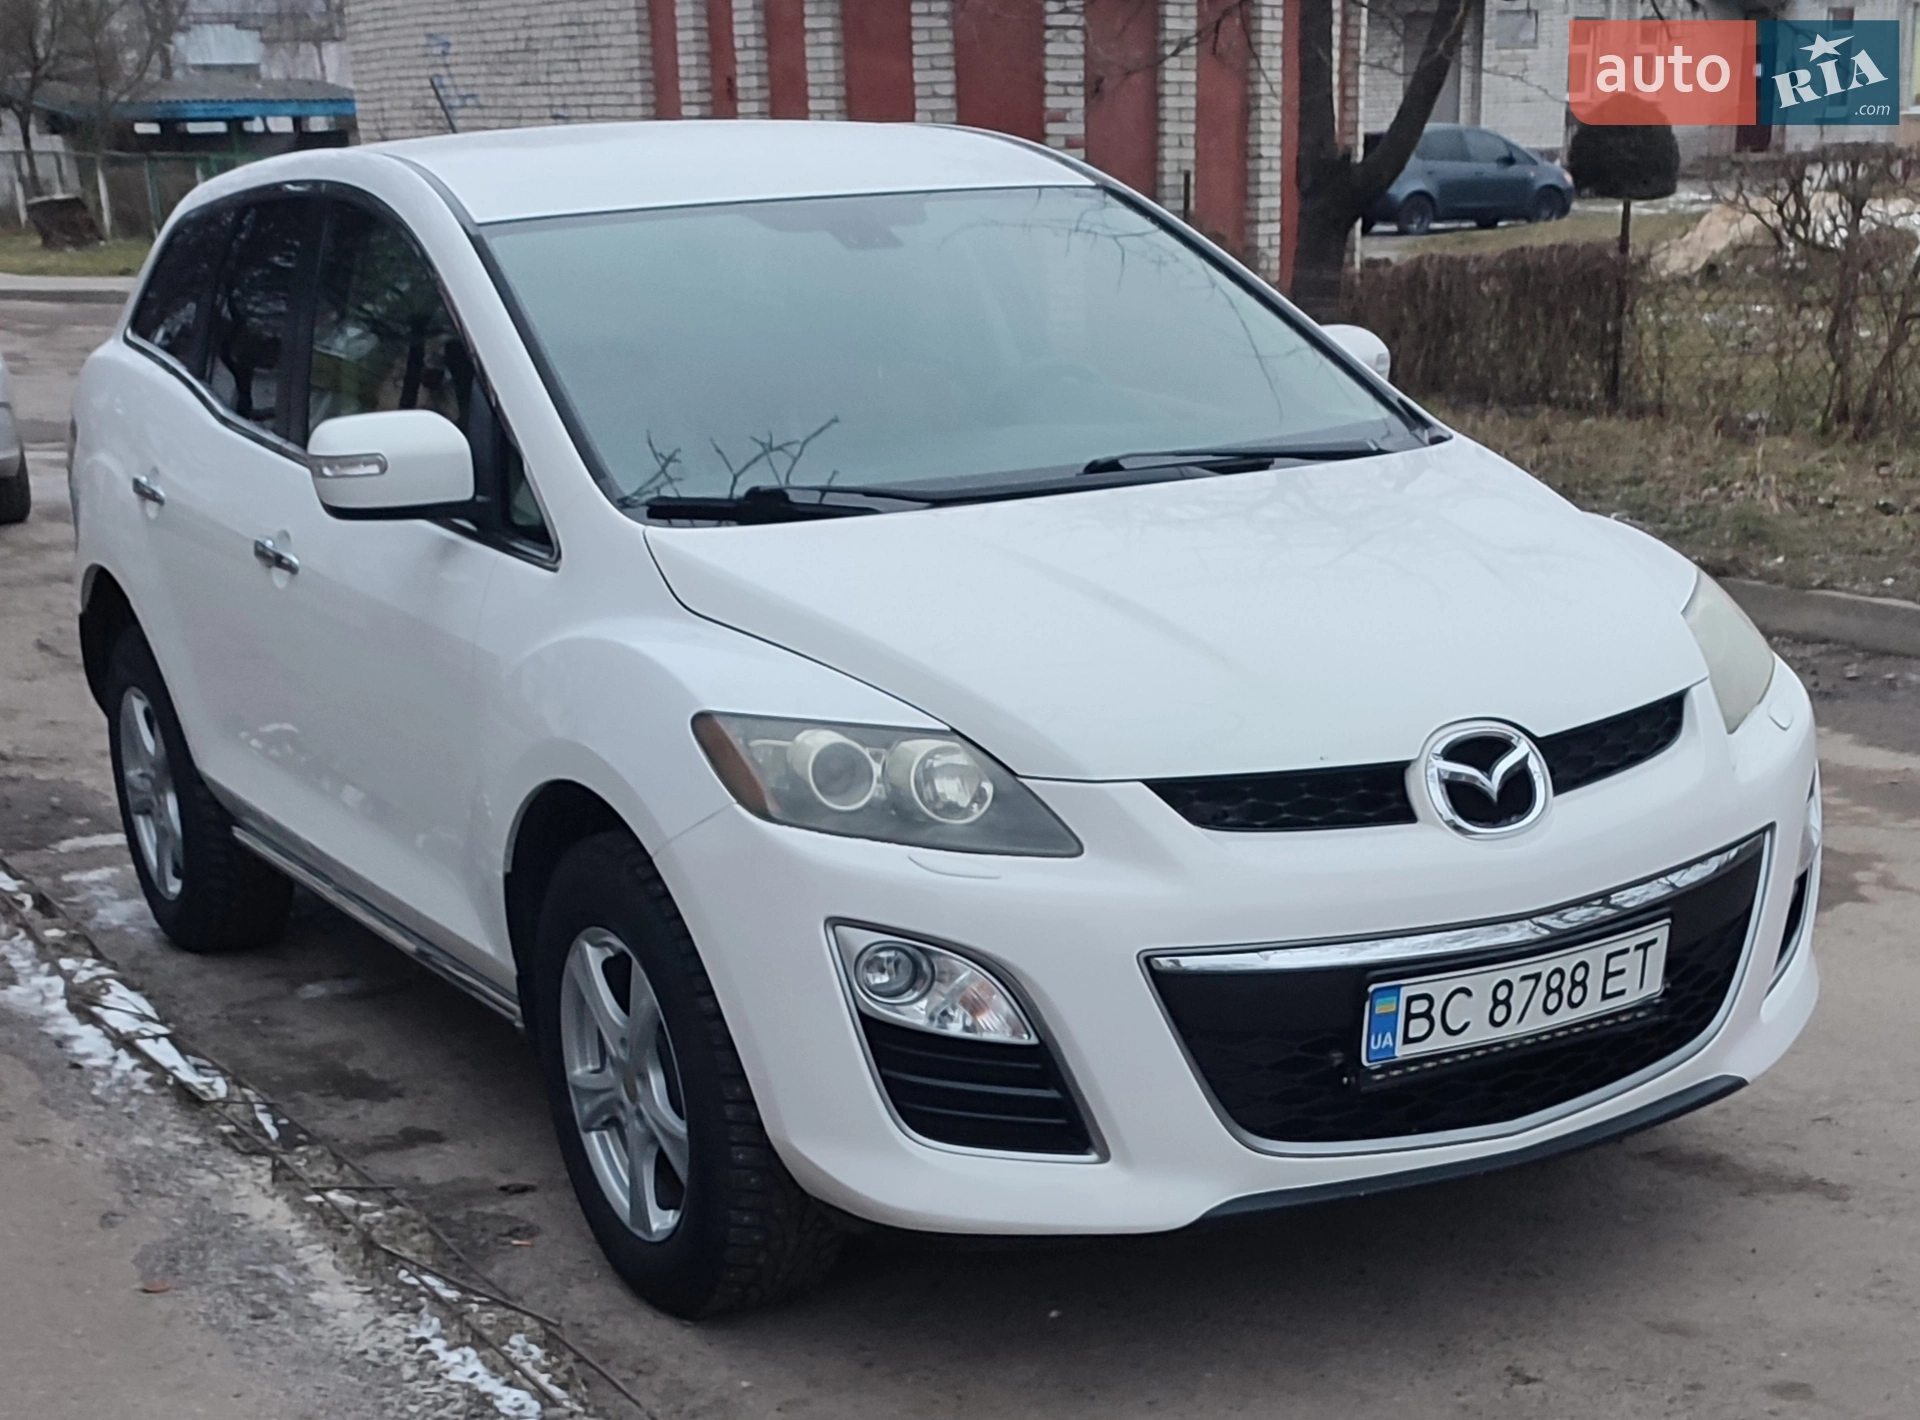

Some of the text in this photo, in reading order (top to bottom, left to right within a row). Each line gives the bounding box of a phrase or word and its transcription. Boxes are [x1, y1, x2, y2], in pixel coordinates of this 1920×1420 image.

[1402, 938, 1659, 1046] BC 8788 ET
[1370, 1032, 1394, 1050] UA
